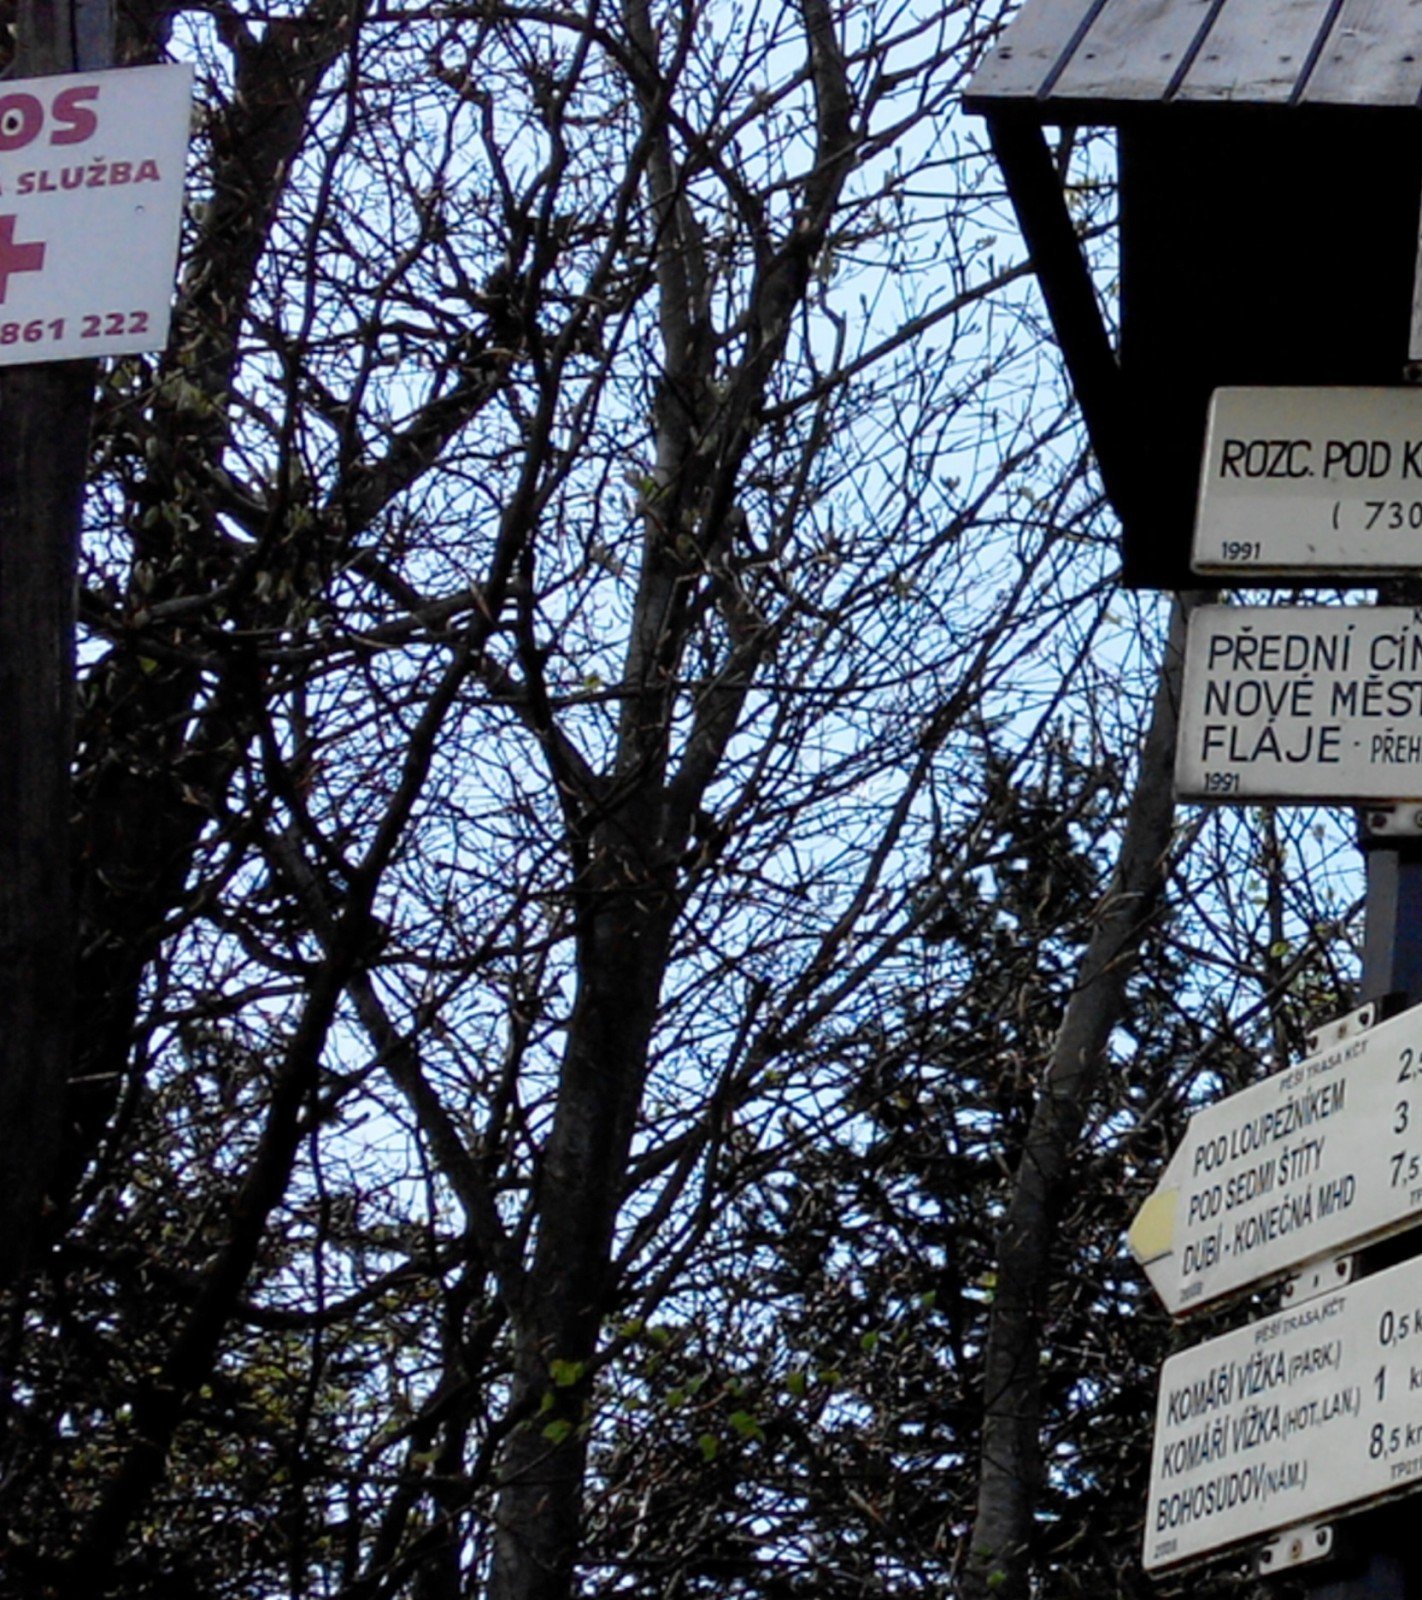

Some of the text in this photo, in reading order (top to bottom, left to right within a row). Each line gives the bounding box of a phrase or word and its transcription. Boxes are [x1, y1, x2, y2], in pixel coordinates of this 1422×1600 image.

[16, 156, 160, 195] SLUŽBA
[80, 311, 149, 338] 222
[1220, 440, 1315, 479] ROZC.
[1323, 440, 1391, 479] POD
[1221, 542, 1261, 560] 1991
[1207, 625, 1355, 672] PŘEDNÍ
[1204, 672, 1313, 717] NOVÉ
[1201, 720, 1341, 765] FLÁJE
[1204, 772, 1240, 792] 1991
[1193, 1138, 1229, 1178] POD
[1229, 1078, 1347, 1162] LOUPEŽNÍKEM
[1188, 1187, 1224, 1227] POD
[1225, 1171, 1275, 1213] SEDMI
[1278, 1136, 1327, 1196] ŠTÍTY
[1393, 1101, 1410, 1135] 3
[1182, 1229, 1223, 1277] DUBÍ
[1233, 1193, 1314, 1253] KONEČNÁ
[1317, 1174, 1357, 1219] MHD
[1390, 1152, 1420, 1191] 7,5
[1166, 1366, 1235, 1429] KOMÁŘÍ
[1379, 1310, 1410, 1347] 0,5
[1160, 1423, 1230, 1481] KOMÁŘÍ
[1373, 1364, 1387, 1404] 1
[1369, 1421, 1400, 1460] 8,5
